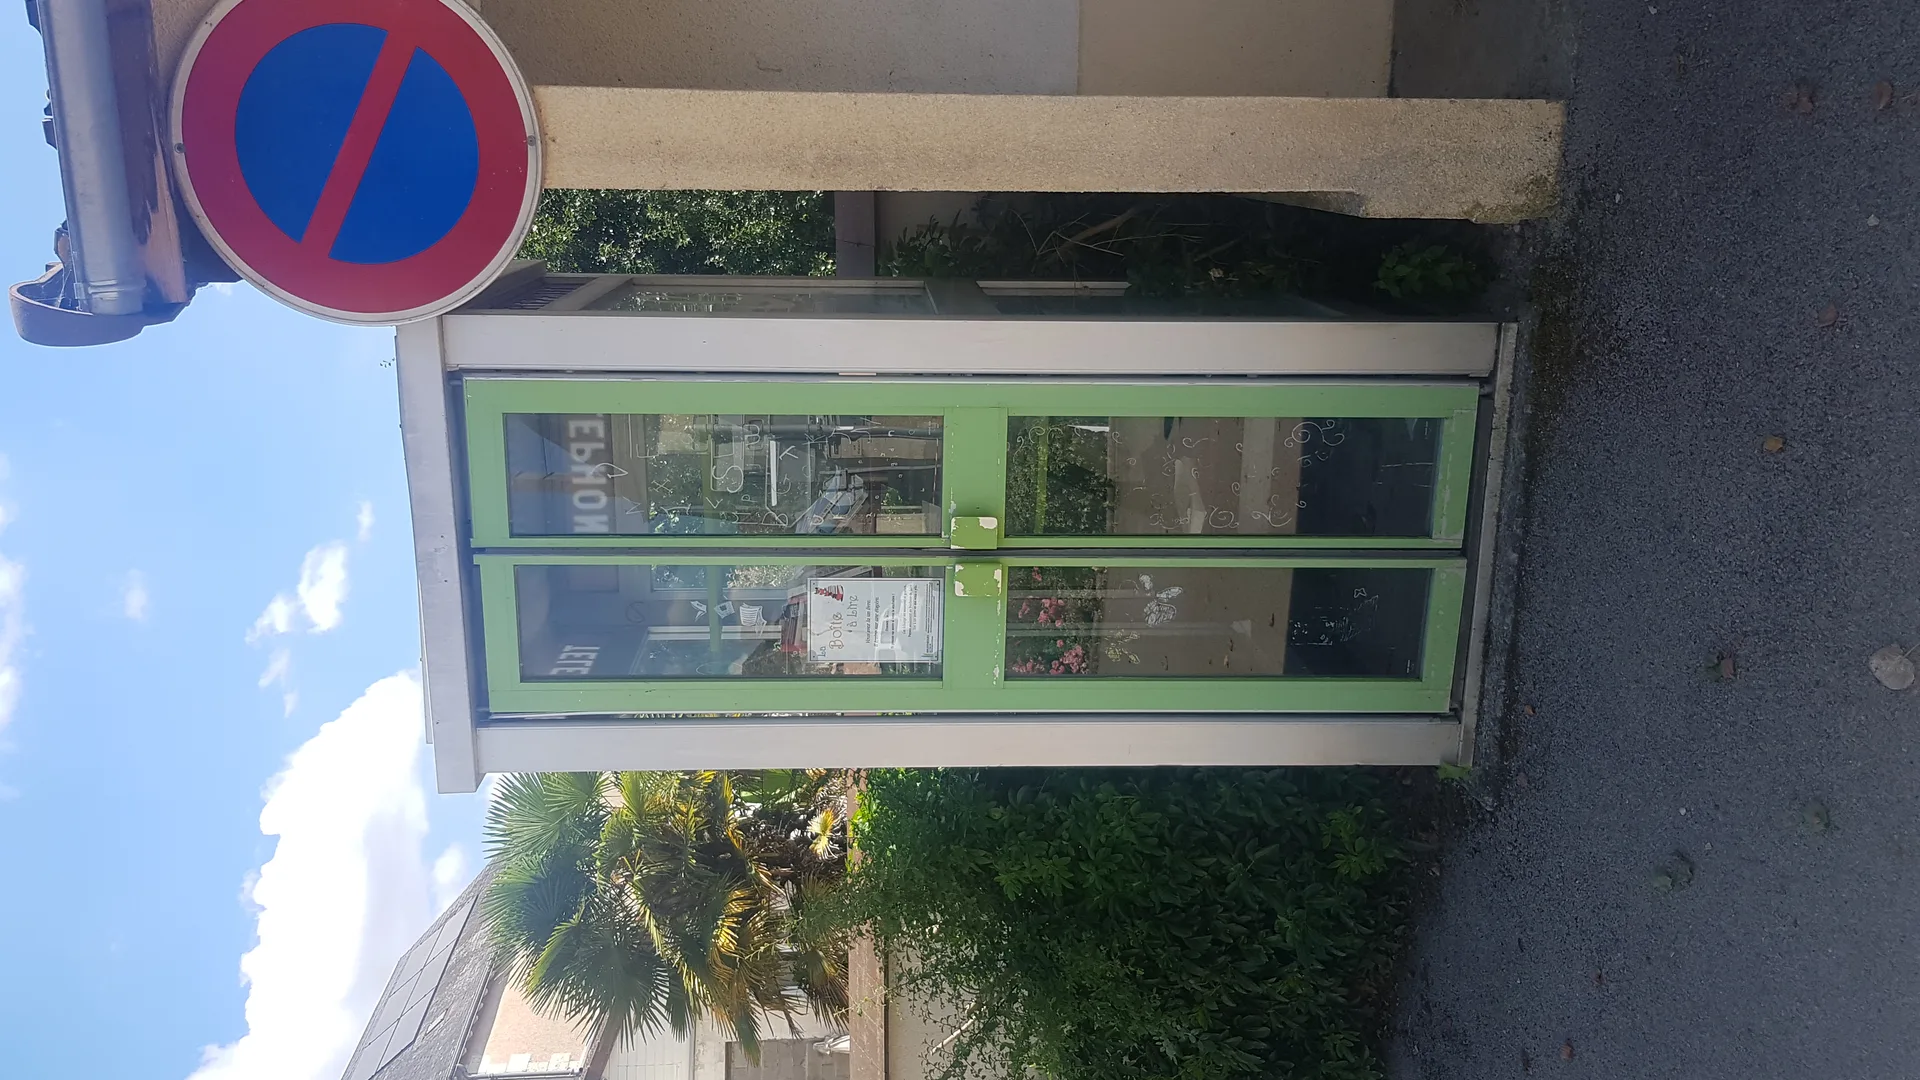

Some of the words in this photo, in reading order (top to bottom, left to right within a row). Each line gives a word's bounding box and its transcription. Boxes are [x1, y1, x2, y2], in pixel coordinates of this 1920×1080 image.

[846, 594, 859, 618] Lire
[828, 611, 844, 650] Boîte
[846, 620, 858, 628] à
[817, 646, 827, 657] La
